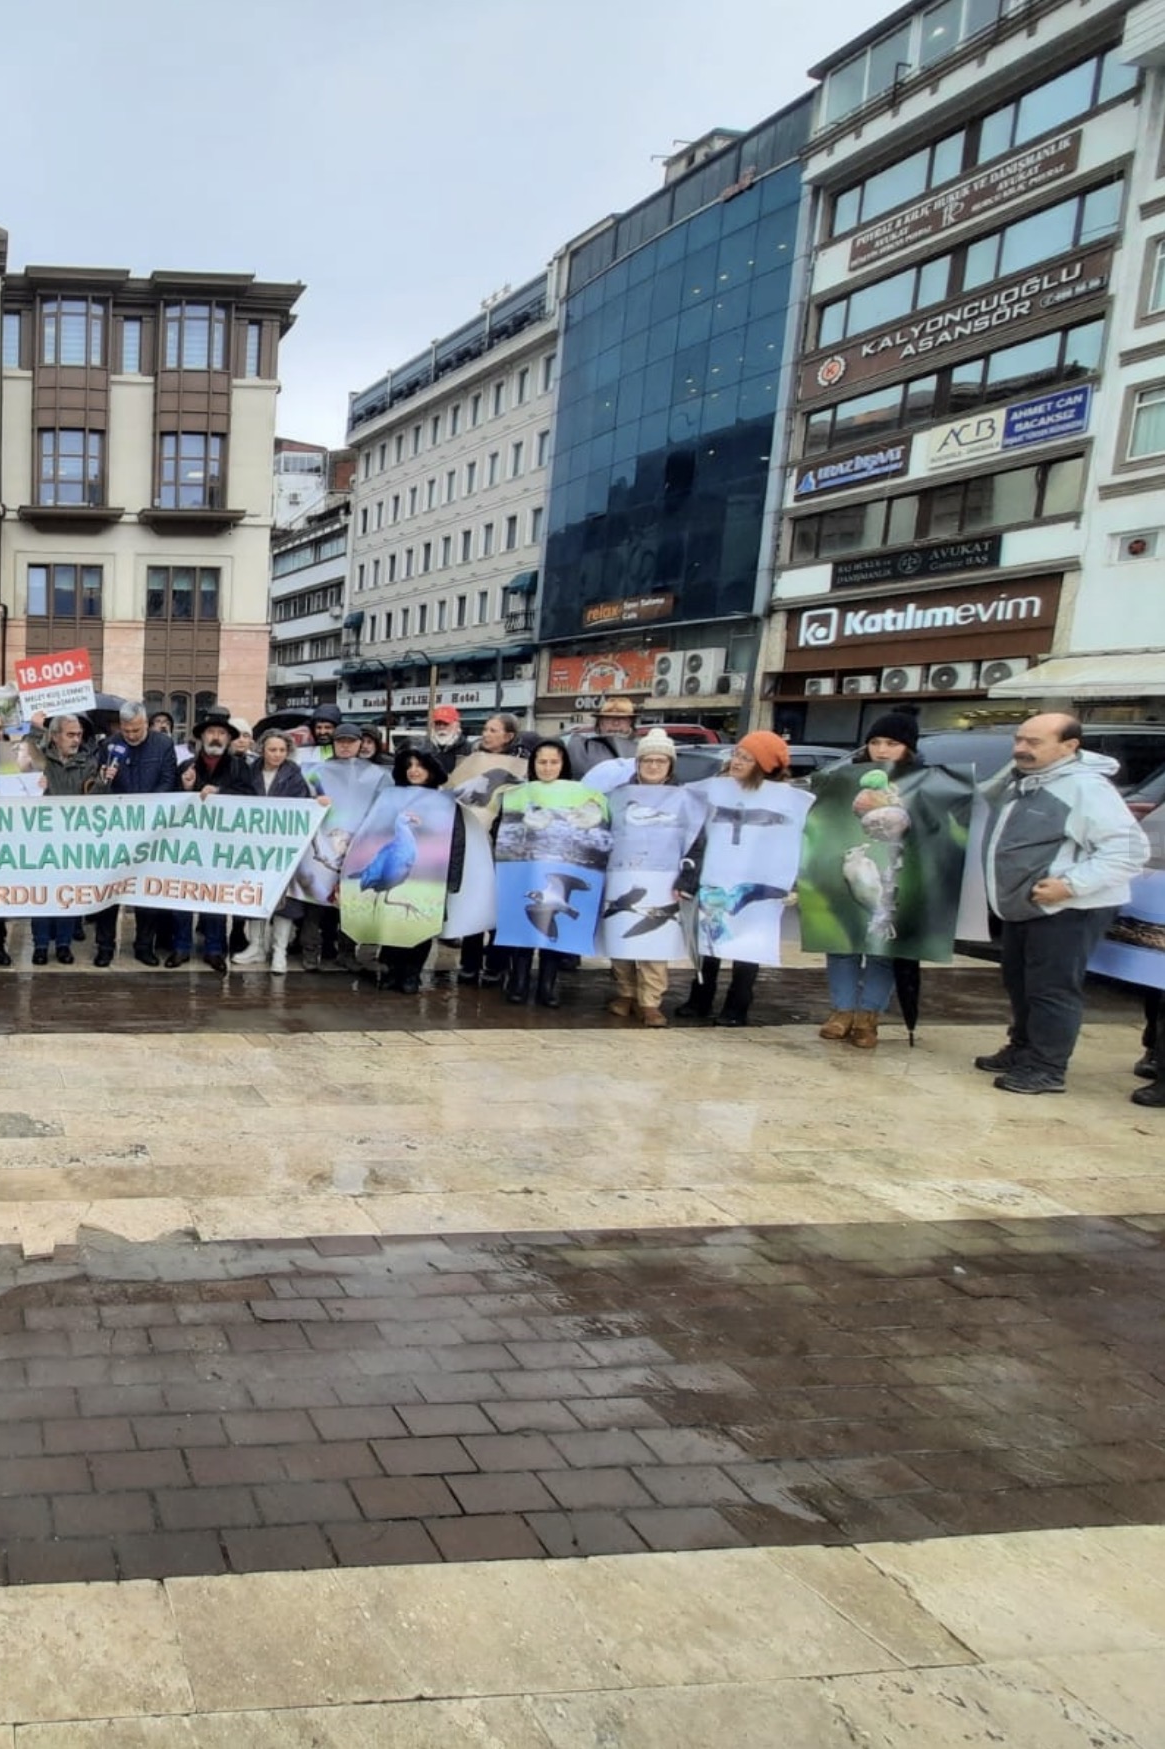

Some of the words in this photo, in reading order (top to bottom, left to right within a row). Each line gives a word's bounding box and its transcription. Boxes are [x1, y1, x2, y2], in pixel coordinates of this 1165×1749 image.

[933, 188, 970, 211] HUKUK
[973, 178, 988, 194] VE
[990, 136, 1073, 183] DANIŞMANLIK
[995, 164, 1041, 192] AVUKAT
[861, 263, 1083, 358] KALYONCUOĞLU
[899, 300, 1031, 360] ASANSÖR
[1010, 402, 1054, 422] AHMET
[1056, 393, 1084, 409] CAN
[1013, 408, 1076, 433] BACAKSIZ
[929, 541, 993, 561] AVUKAT
[587, 603, 619, 622] relax
[843, 592, 1042, 637] Katılımevim
[19, 660, 86, 685] 18.000+
[400, 694, 443, 706] ATLIHN
[451, 691, 480, 703] Hotel
[21, 805, 53, 832] VE
[60, 804, 145, 838] YAŞAM
[152, 804, 311, 836] ALANLARININ
[56, 877, 137, 911] ÇEVRE
[144, 876, 263, 906] DERNEĞİ
